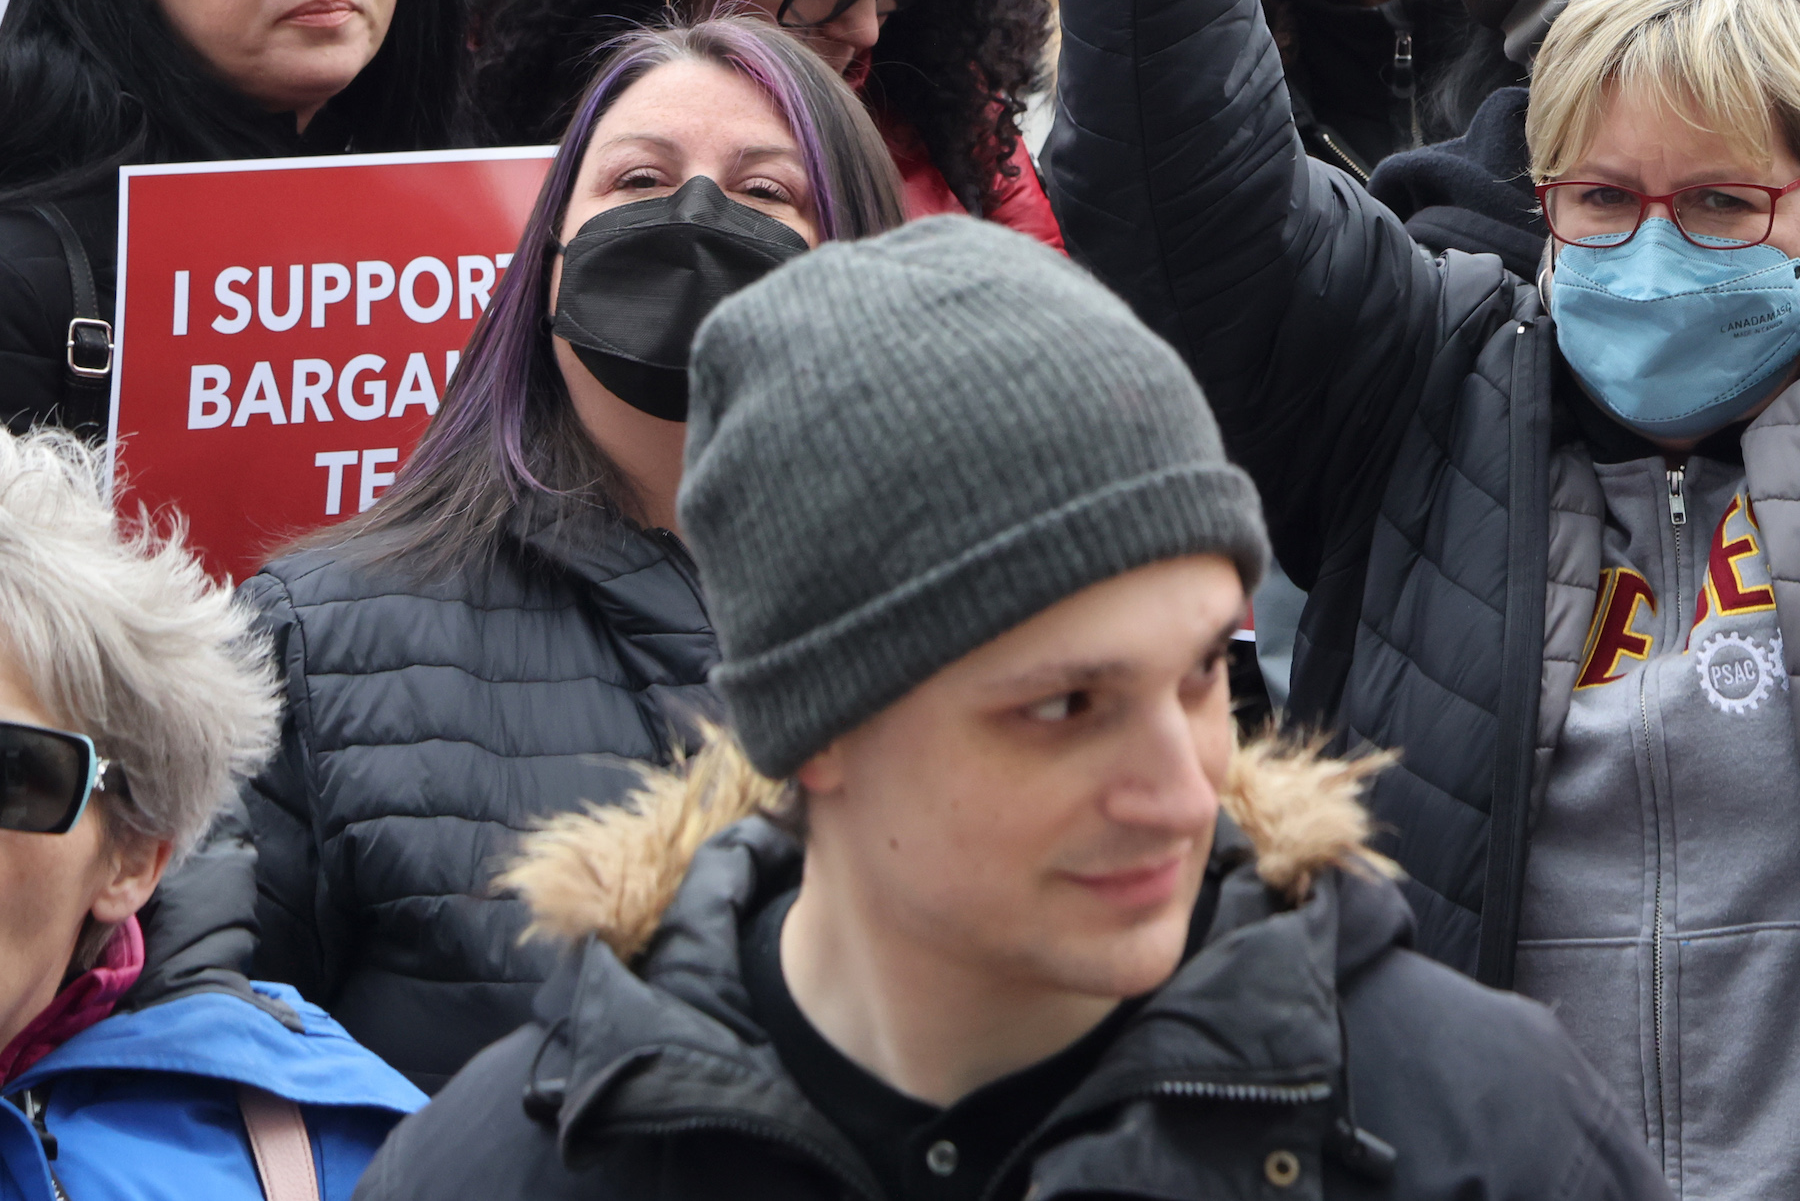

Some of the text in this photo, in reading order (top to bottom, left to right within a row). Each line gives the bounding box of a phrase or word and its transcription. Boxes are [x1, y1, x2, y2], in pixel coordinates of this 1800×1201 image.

[173, 253, 515, 336] I SUPPOR
[1720, 302, 1792, 334] CANADAMASQ
[1710, 659, 1757, 690] PSAC
